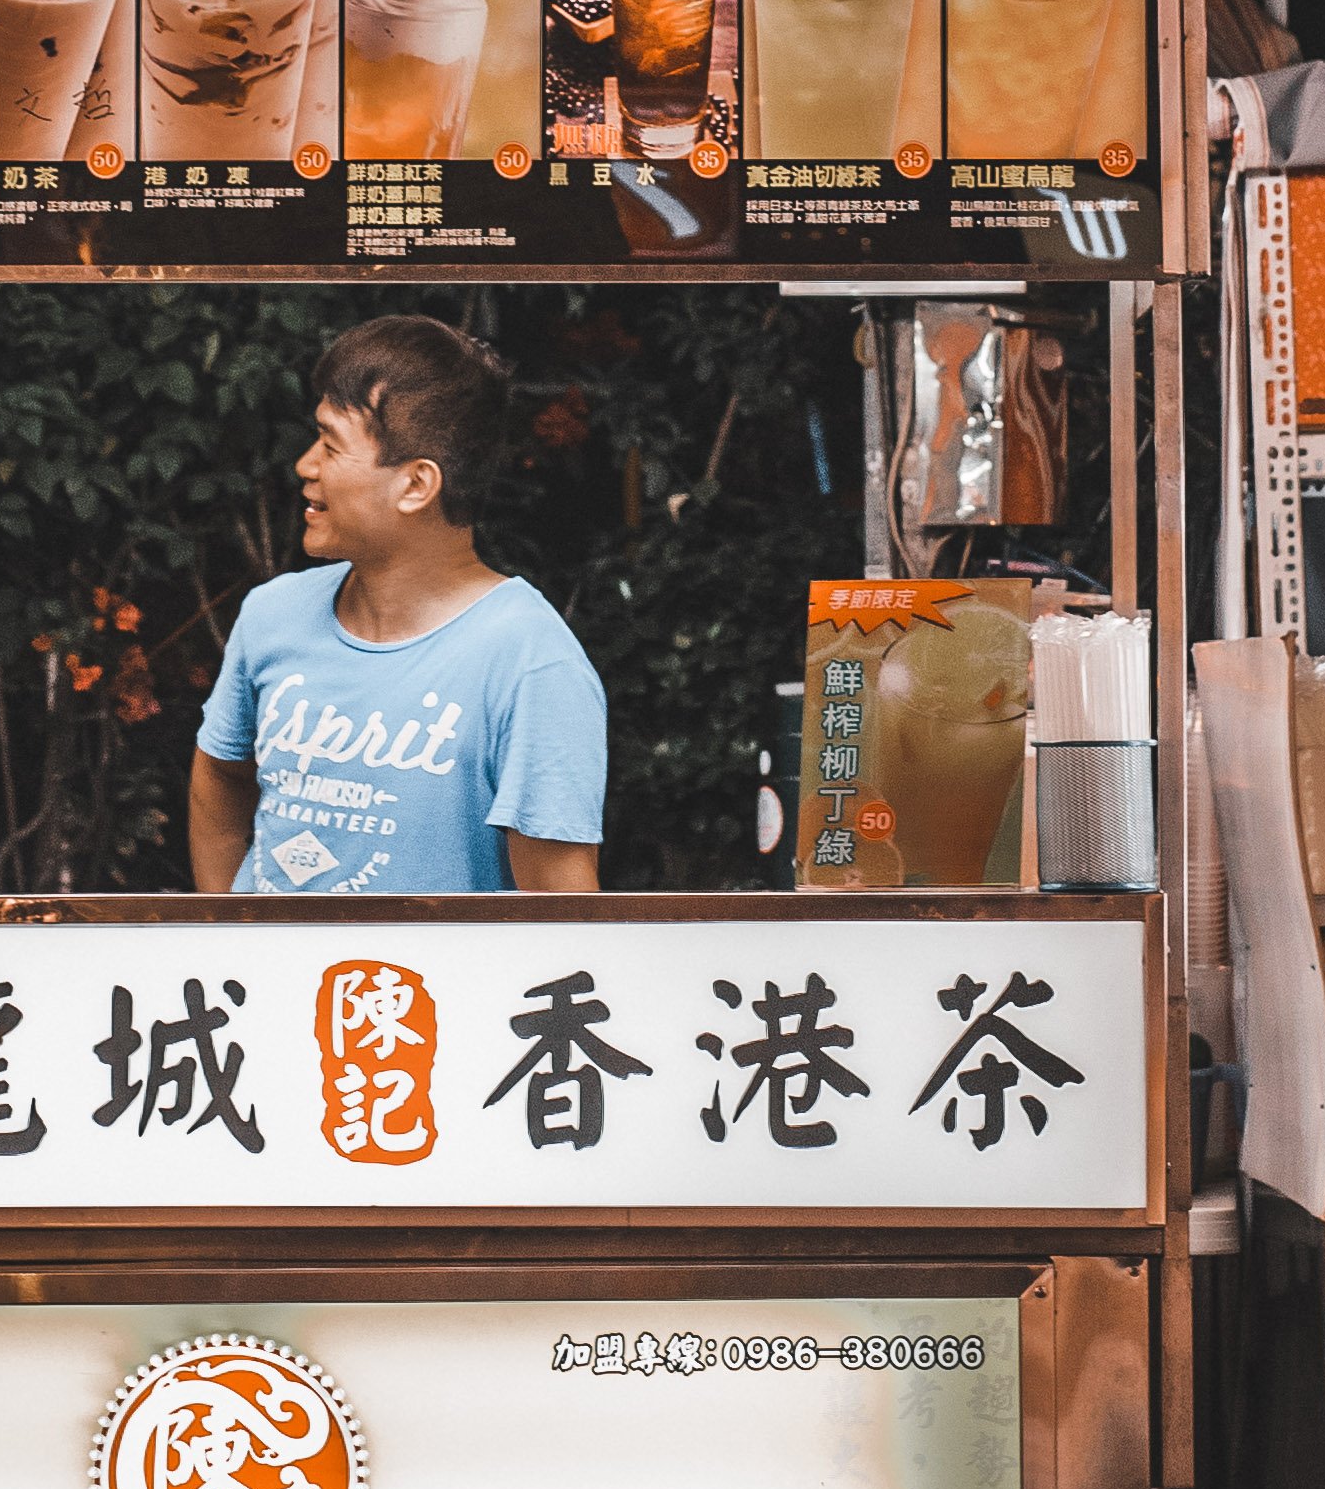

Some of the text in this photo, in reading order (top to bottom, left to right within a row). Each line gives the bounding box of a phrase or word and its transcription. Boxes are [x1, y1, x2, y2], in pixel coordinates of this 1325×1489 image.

[92, 150, 117, 169] 50
[299, 150, 324, 169] 50
[500, 150, 525, 169] 50
[697, 149, 722, 168] 35
[900, 149, 925, 168] 35
[1104, 148, 1129, 167] 35
[144, 166, 250, 186] 港奶凍
[549, 162, 656, 186] 黑豆水
[746, 165, 881, 188] 黃金油切綠茶
[950, 164, 1076, 189] 高山蜜烏龍
[828, 588, 918, 611] 季節限定
[253, 673, 463, 776] Esprit
[814, 658, 865, 867] 鮮榨柳丁綠
[860, 812, 893, 832] 50
[331, 967, 429, 1157] 陳記
[481, 970, 1087, 1154] 香港茶
